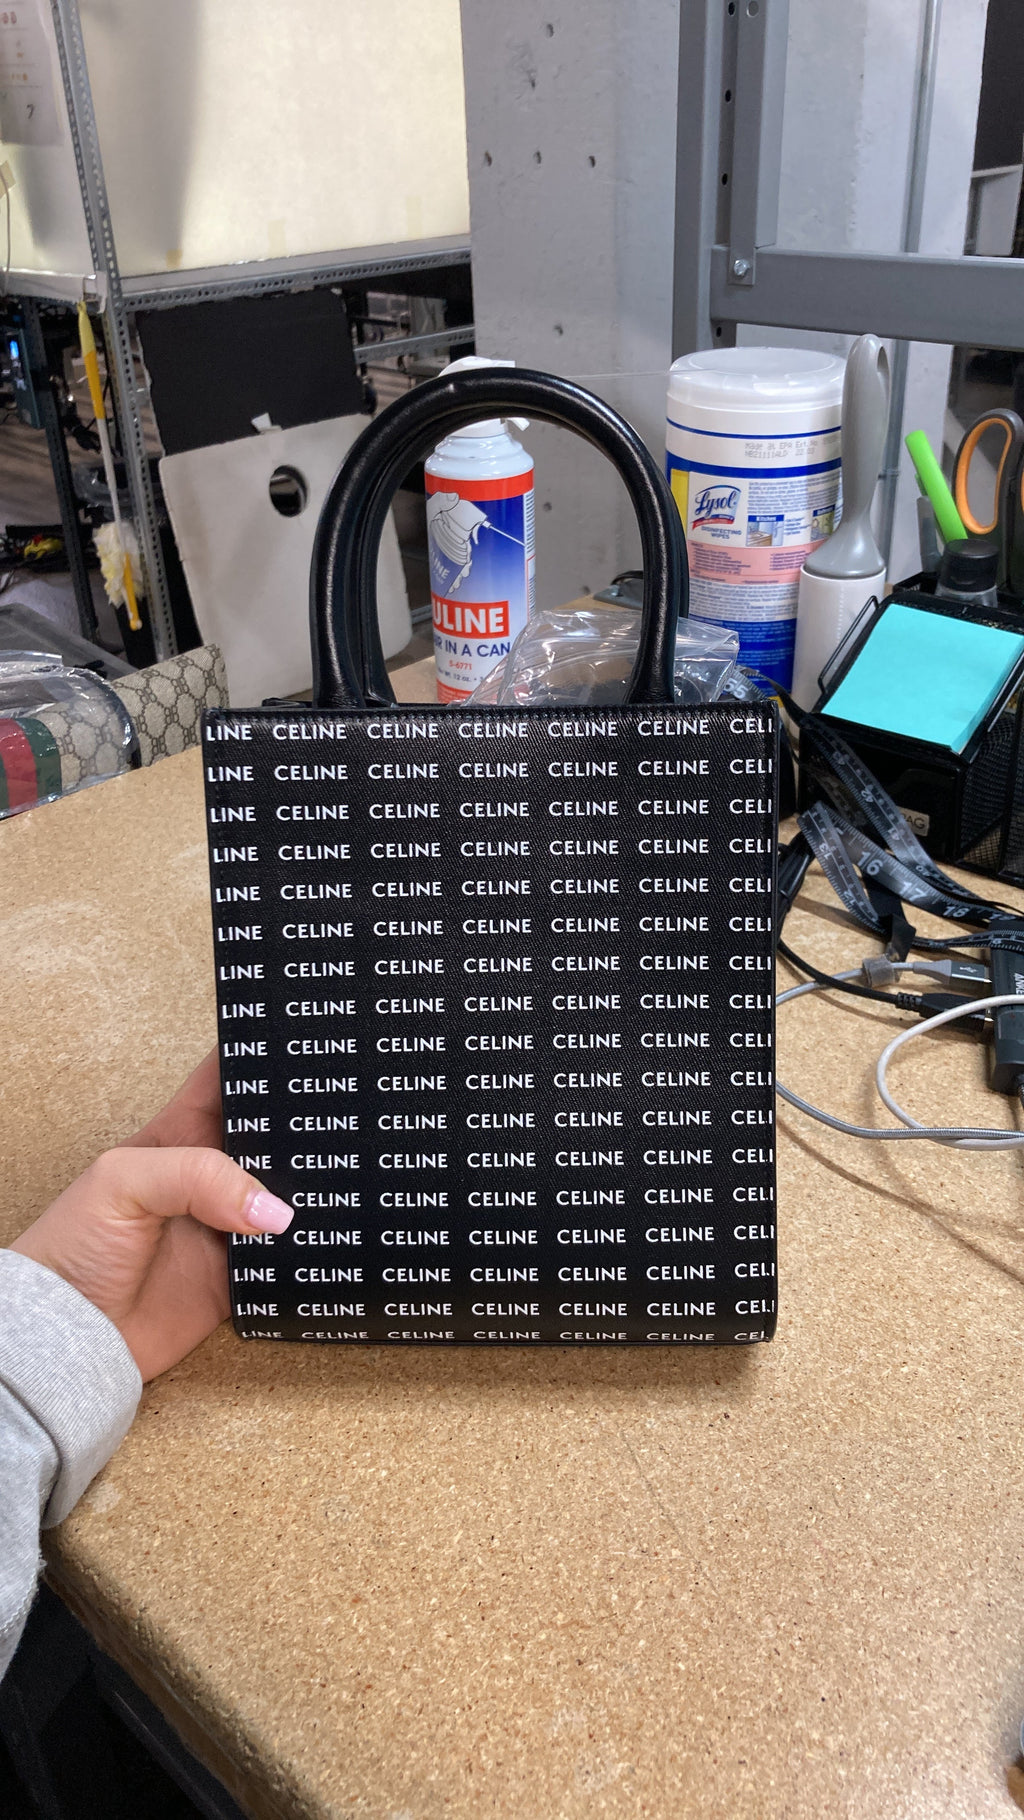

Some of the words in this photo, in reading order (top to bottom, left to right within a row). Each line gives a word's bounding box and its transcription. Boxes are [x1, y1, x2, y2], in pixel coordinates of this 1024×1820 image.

[694, 489, 737, 518] Lysol
[433, 600, 504, 634] ULINE
[445, 640, 457, 655] IN
[461, 643, 472, 658] A
[477, 642, 511, 658] CAN
[206, 725, 252, 742] LINE
[272, 724, 347, 740] CELINE
[367, 723, 439, 739] CELINE
[458, 722, 529, 738] CELINE
[547, 721, 618, 737] CELINE
[637, 719, 709, 736] CELINE
[730, 718, 773, 734] CELI
[209, 766, 254, 782] LINE
[274, 765, 348, 780] CELINE
[368, 764, 439, 779] CELINE
[459, 762, 528, 778] CELINE
[548, 762, 618, 777] CELINE
[638, 760, 709, 775] CELINE
[730, 759, 772, 774] CELI
[211, 807, 256, 822] LINE
[276, 805, 349, 820] CELINE
[369, 803, 440, 819] CELINE
[460, 802, 529, 817] CELINE
[549, 801, 618, 816] CELINE
[638, 800, 709, 815] CELINE
[730, 799, 771, 814] CELI
[214, 847, 258, 863] LINE
[278, 845, 350, 860] CELINE
[371, 843, 441, 858] CELINE
[461, 841, 530, 856] CELINE
[550, 840, 618, 855] CELINE
[639, 839, 709, 854] CELINE
[729, 839, 770, 853] CELI
[858, 851, 884, 876] 16
[216, 886, 260, 902] LINE
[280, 884, 352, 899] CELINE
[372, 882, 442, 897] CELINE
[462, 880, 530, 895] CELINE
[550, 879, 619, 894] CELINE
[639, 878, 709, 893] CELINE
[729, 878, 771, 892] CELI
[899, 881, 927, 903] 17
[218, 926, 262, 941] LINE
[283, 923, 354, 939] CELINE
[374, 921, 443, 936] CELINE
[463, 919, 531, 934] CELINE
[551, 918, 619, 932] CELINE
[639, 917, 709, 931] CELINE
[729, 917, 771, 931] CELI
[221, 965, 264, 980] LINE
[284, 962, 355, 977] CELINE
[375, 959, 444, 975] CELINE
[464, 958, 532, 973] CELINE
[552, 956, 620, 971] CELINE
[640, 956, 709, 970] CELINE
[729, 956, 771, 970] CELI
[223, 1003, 266, 1019] LINE
[286, 1000, 356, 1016] CELINE
[376, 998, 445, 1014] CELINE
[464, 996, 533, 1011] CELINE
[552, 995, 621, 1010] CELINE
[640, 994, 709, 1009] CELINE
[729, 994, 771, 1009] CELI
[224, 1042, 267, 1057] LINE
[287, 1039, 357, 1055] CELINE
[377, 1037, 445, 1052] CELINE
[465, 1035, 533, 1050] CELINE
[553, 1034, 621, 1049] CELINE
[641, 1033, 710, 1047] CELINE
[730, 1033, 771, 1047] CELI
[226, 1080, 269, 1095] LINE
[288, 1078, 358, 1093] CELINE
[378, 1076, 446, 1091] CELINE
[466, 1074, 534, 1089] CELINE
[554, 1073, 622, 1088] CELINE
[642, 1072, 710, 1086] CELINE
[731, 1071, 771, 1086] CELI
[228, 1118, 270, 1133] LINE
[290, 1116, 359, 1131] CELINE
[378, 1115, 447, 1129] CELINE
[467, 1113, 535, 1128] CELINE
[555, 1112, 623, 1127] CELINE
[643, 1111, 711, 1126] CELINE
[731, 1110, 772, 1124] CELI
[231, 1156, 272, 1170] INE
[291, 1155, 360, 1169] CELINE
[379, 1154, 447, 1168] CELINE
[467, 1152, 536, 1167] CELINE
[556, 1151, 624, 1166] CELINE
[644, 1150, 712, 1165] CELINE
[732, 1149, 773, 1163] CELI
[292, 1193, 360, 1207] CELINE
[380, 1193, 448, 1207] CELINE
[468, 1192, 536, 1206] CELINE
[556, 1190, 625, 1205] CELINE
[645, 1189, 713, 1204] CELINE
[733, 1187, 773, 1202] CELI
[294, 1231, 362, 1245] CELINE
[381, 1231, 449, 1245] CELINE
[469, 1230, 537, 1245] CELINE
[557, 1229, 626, 1244] CELINE
[646, 1227, 714, 1242] CELINE
[734, 1225, 774, 1240] CELI
[235, 1268, 276, 1281] LINE
[295, 1268, 363, 1282] CELINE
[383, 1268, 451, 1282] CELINE
[470, 1268, 538, 1281] CELINE
[558, 1267, 626, 1281] CELINE
[647, 1265, 715, 1280] CELINE
[237, 1304, 278, 1315] LINE
[297, 1304, 365, 1316] CELINE
[385, 1304, 452, 1315] CELINE
[472, 1303, 539, 1315] CELINE
[559, 1303, 627, 1315] CELINE
[647, 1303, 715, 1316] CELINE
[242, 1330, 282, 1339] LINE
[301, 1331, 369, 1339] CELINE
[387, 1331, 455, 1339] CELINE
[473, 1331, 541, 1339] CELINE
[559, 1331, 627, 1340] CELINE
[646, 1332, 715, 1341] CELINE
[734, 1331, 769, 1341] CEL
